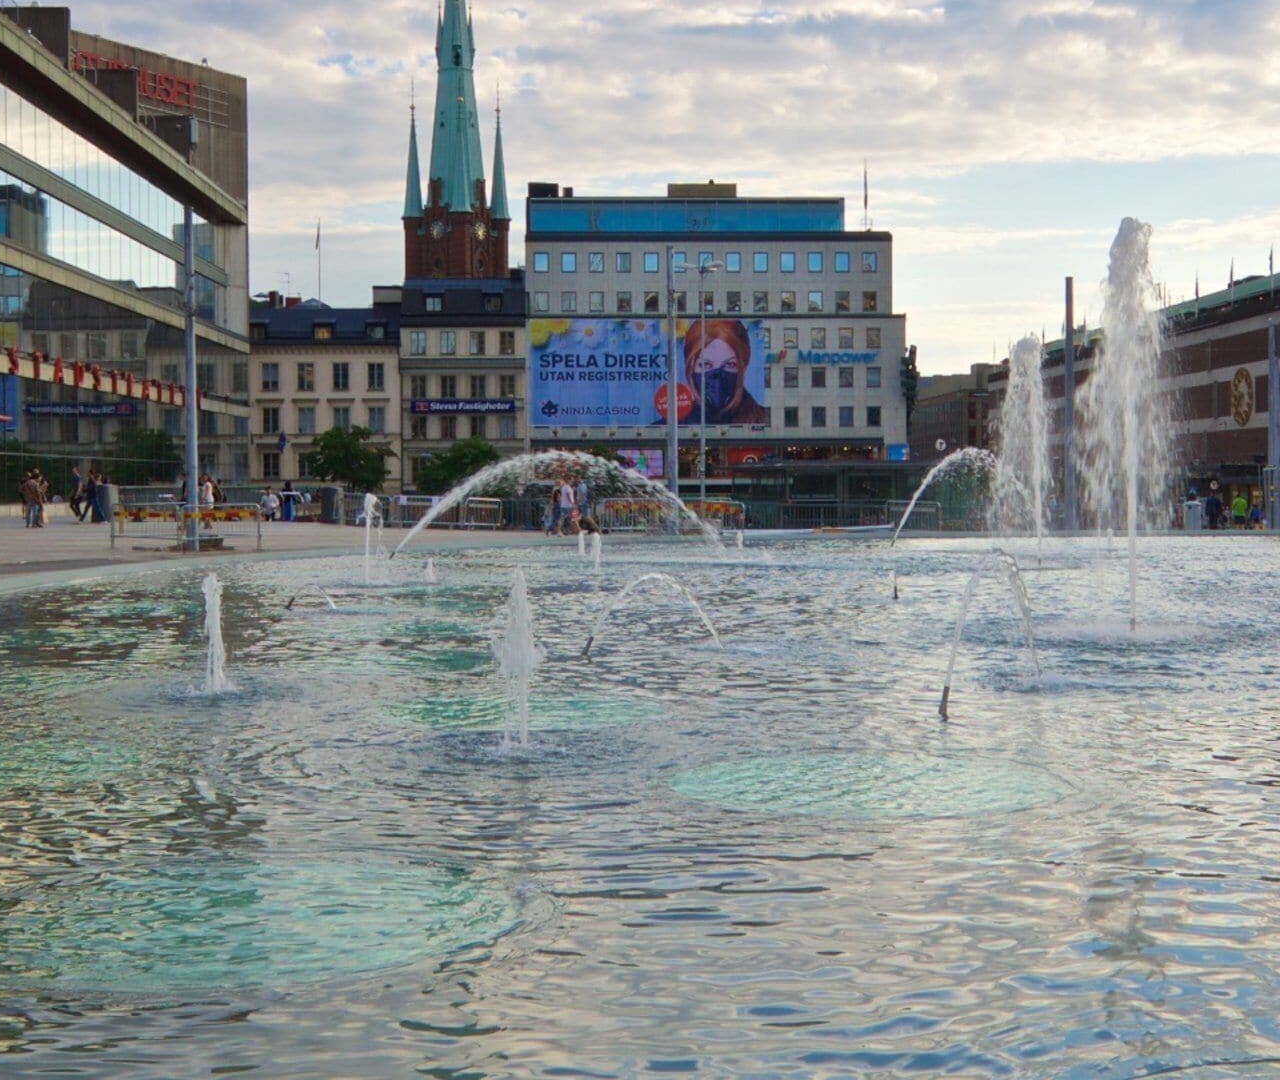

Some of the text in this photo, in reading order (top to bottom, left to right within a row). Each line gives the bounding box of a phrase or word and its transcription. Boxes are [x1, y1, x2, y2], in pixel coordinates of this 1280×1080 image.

[539, 353, 669, 369] SPELA DIREKT
[797, 350, 878, 367] Manpower
[539, 370, 575, 382] UTAN
[430, 401, 512, 412] Stena Fastigheter
[560, 406, 641, 416] NINJA CASINO
